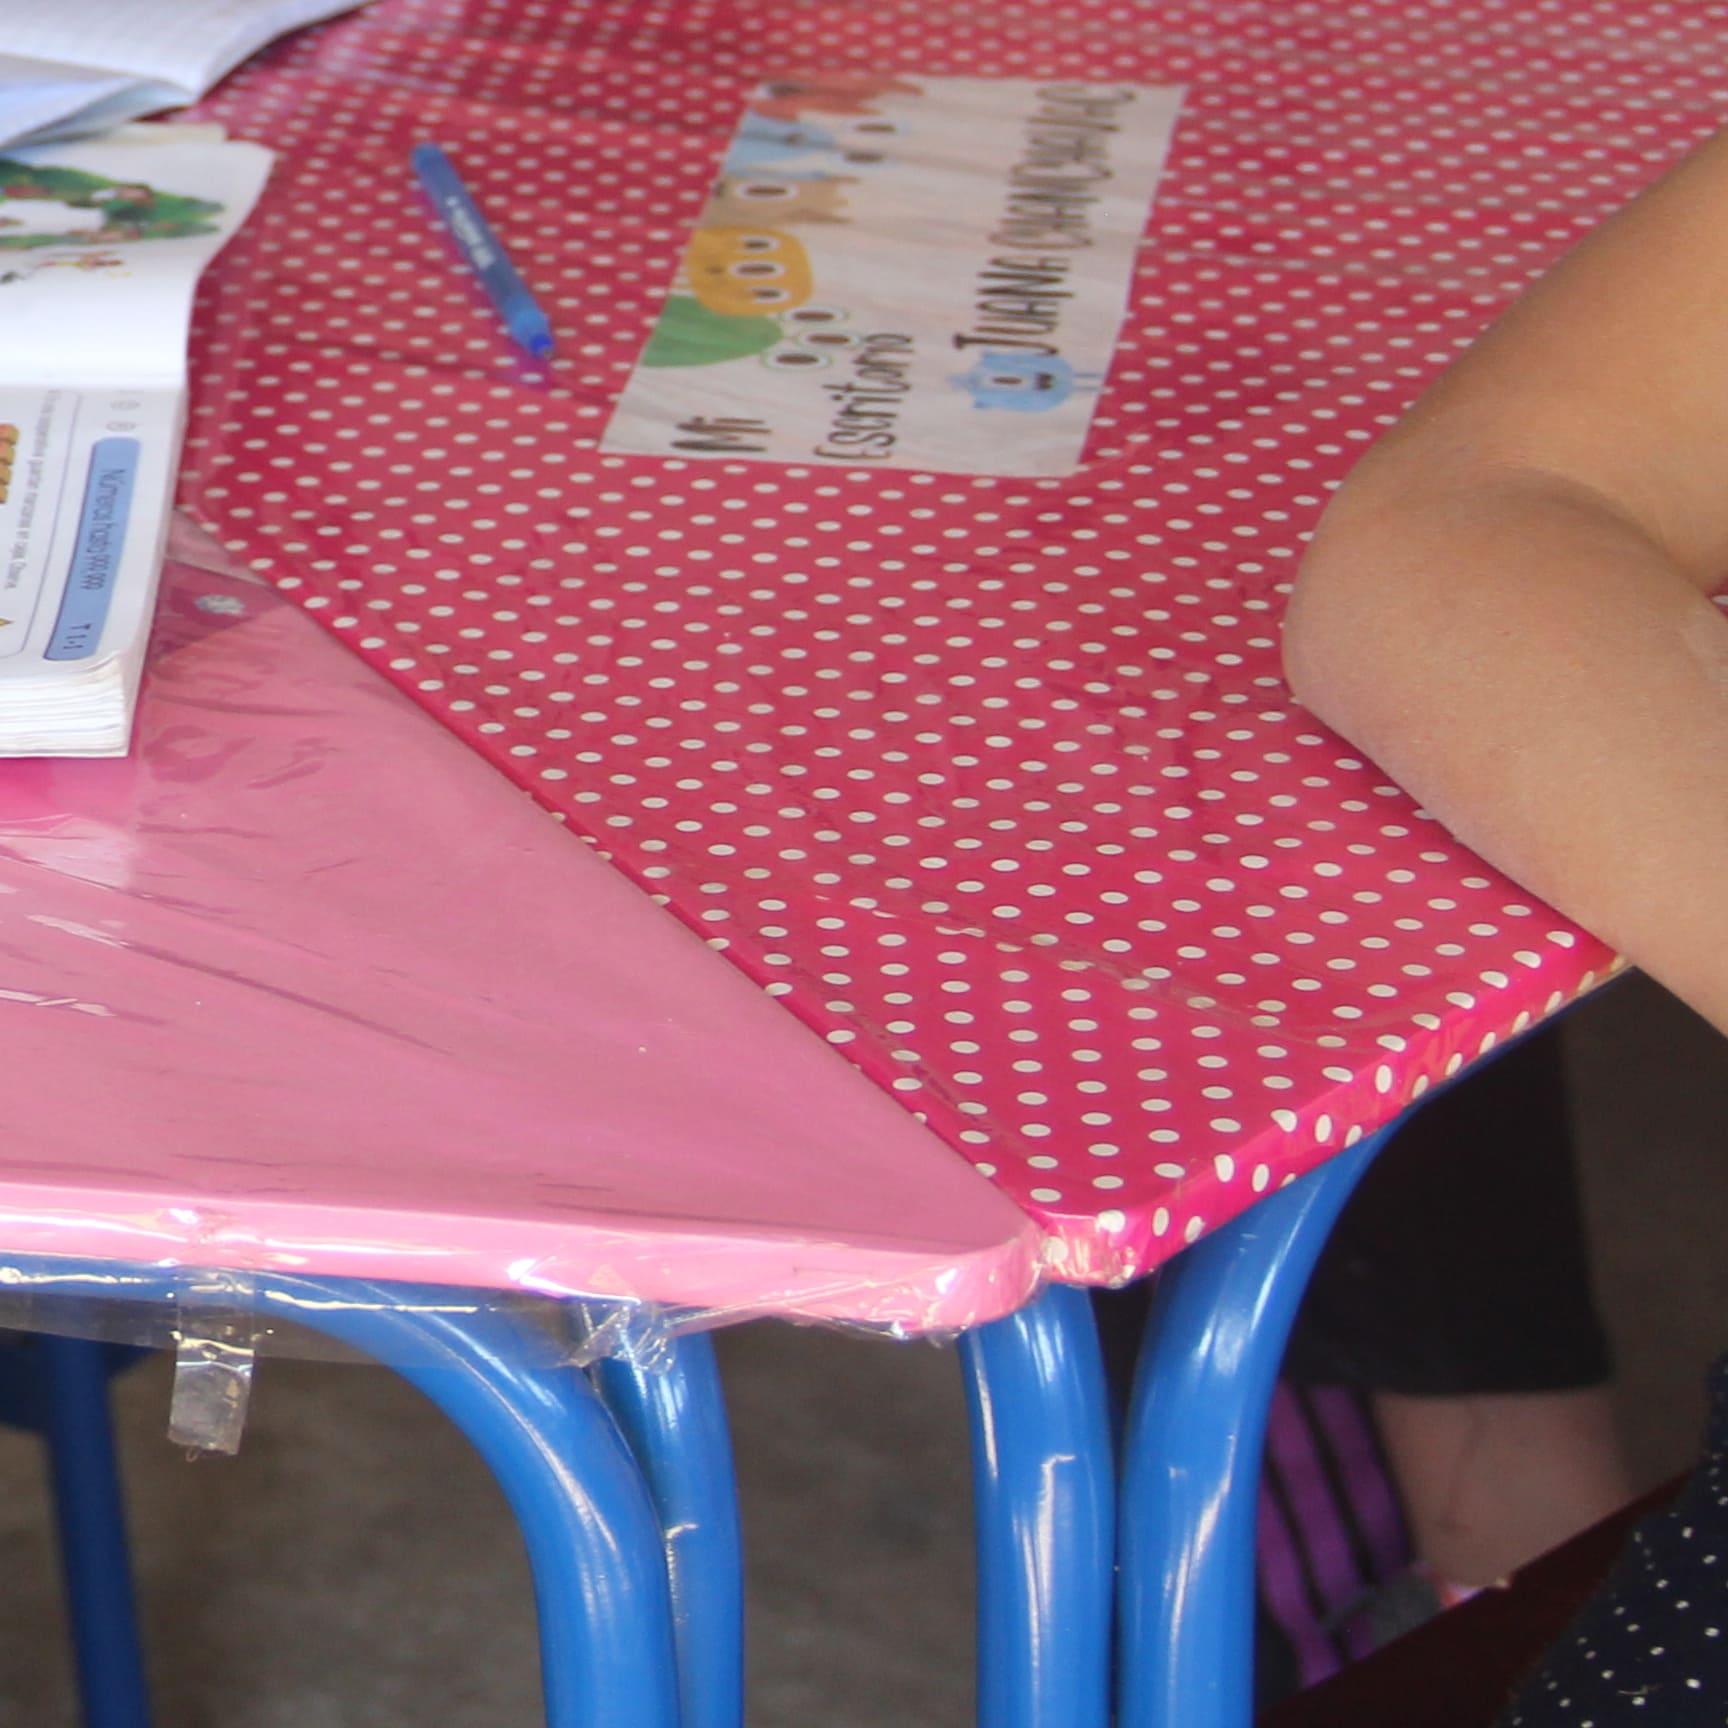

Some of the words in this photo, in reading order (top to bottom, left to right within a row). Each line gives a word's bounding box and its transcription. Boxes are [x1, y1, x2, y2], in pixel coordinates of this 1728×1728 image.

[953, 256, 1079, 357] JUANA
[813, 331, 914, 463] Escritorio
[669, 414, 772, 454] Mi
[91, 469, 127, 520] Números
[85, 522, 115, 552] hasta
